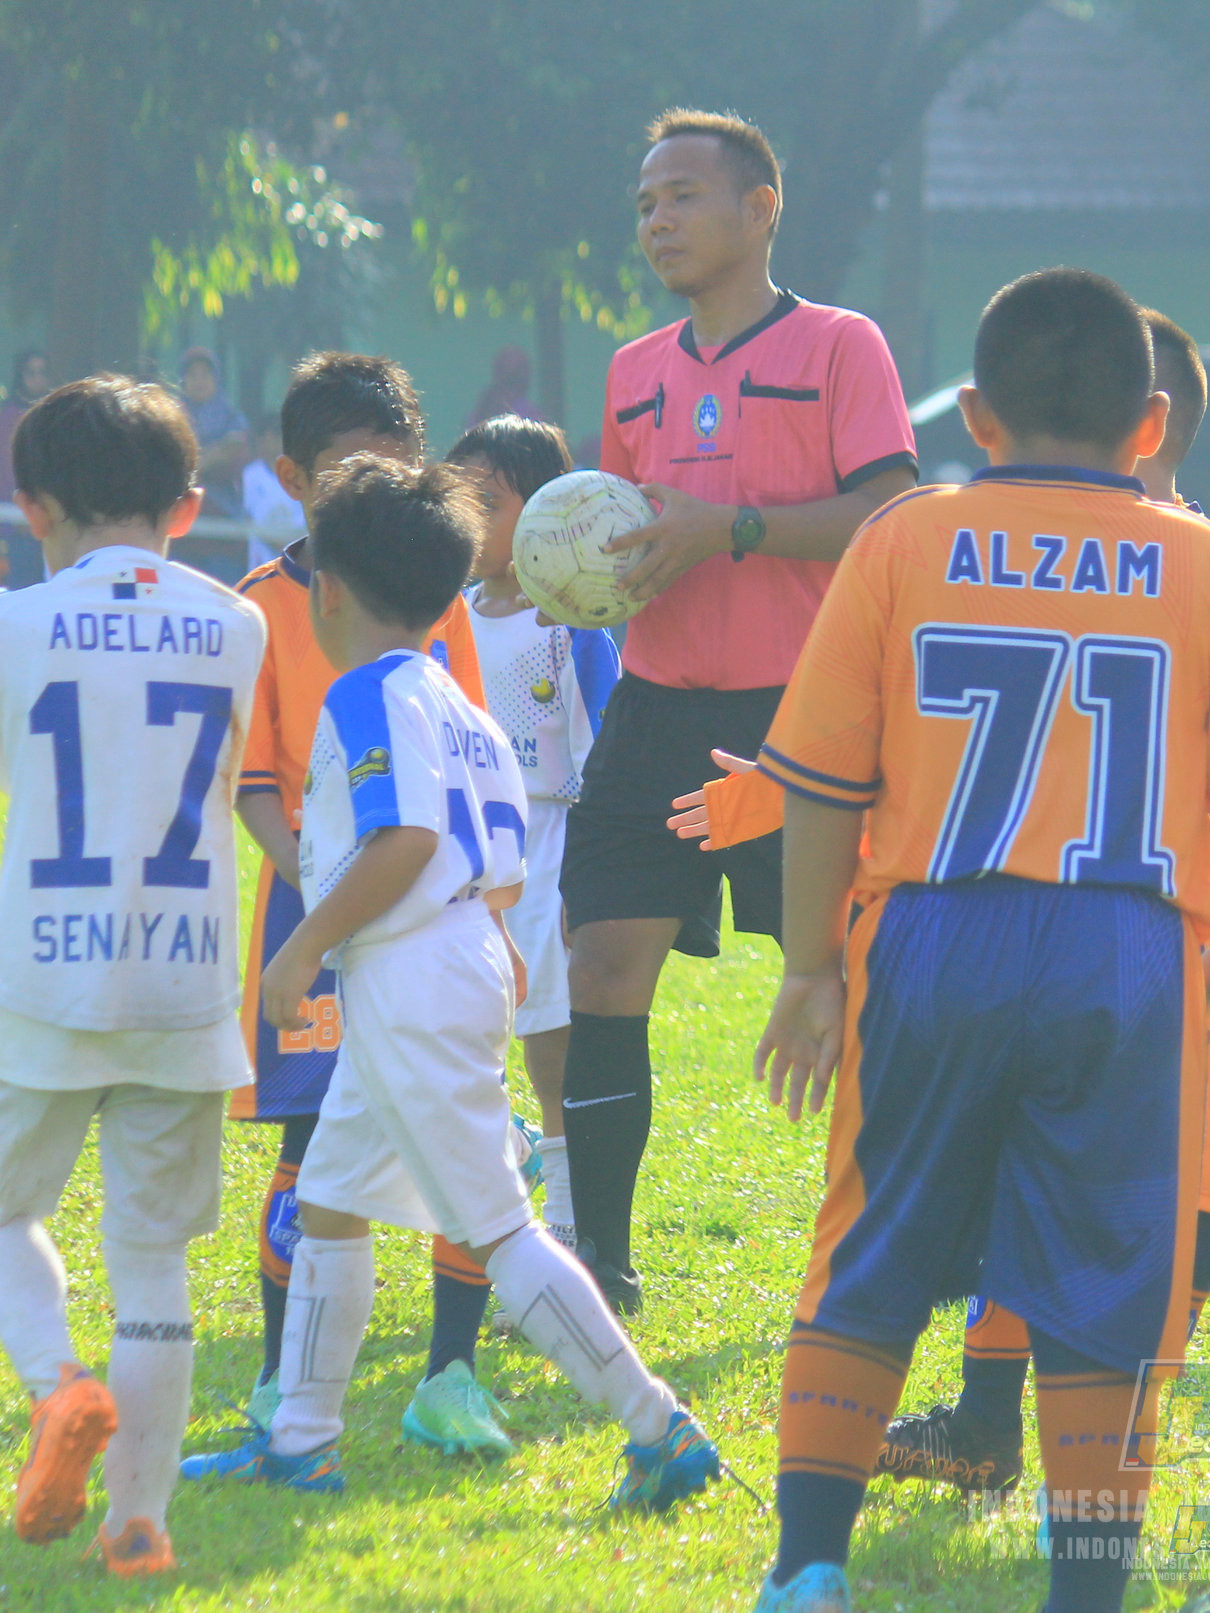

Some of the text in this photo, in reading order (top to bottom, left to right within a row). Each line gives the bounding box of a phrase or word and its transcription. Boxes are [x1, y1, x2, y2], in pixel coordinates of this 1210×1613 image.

[946, 528, 1163, 598] ALZAM
[50, 613, 223, 657] ADELARD
[29, 681, 233, 889] 17
[912, 622, 1177, 898] 71
